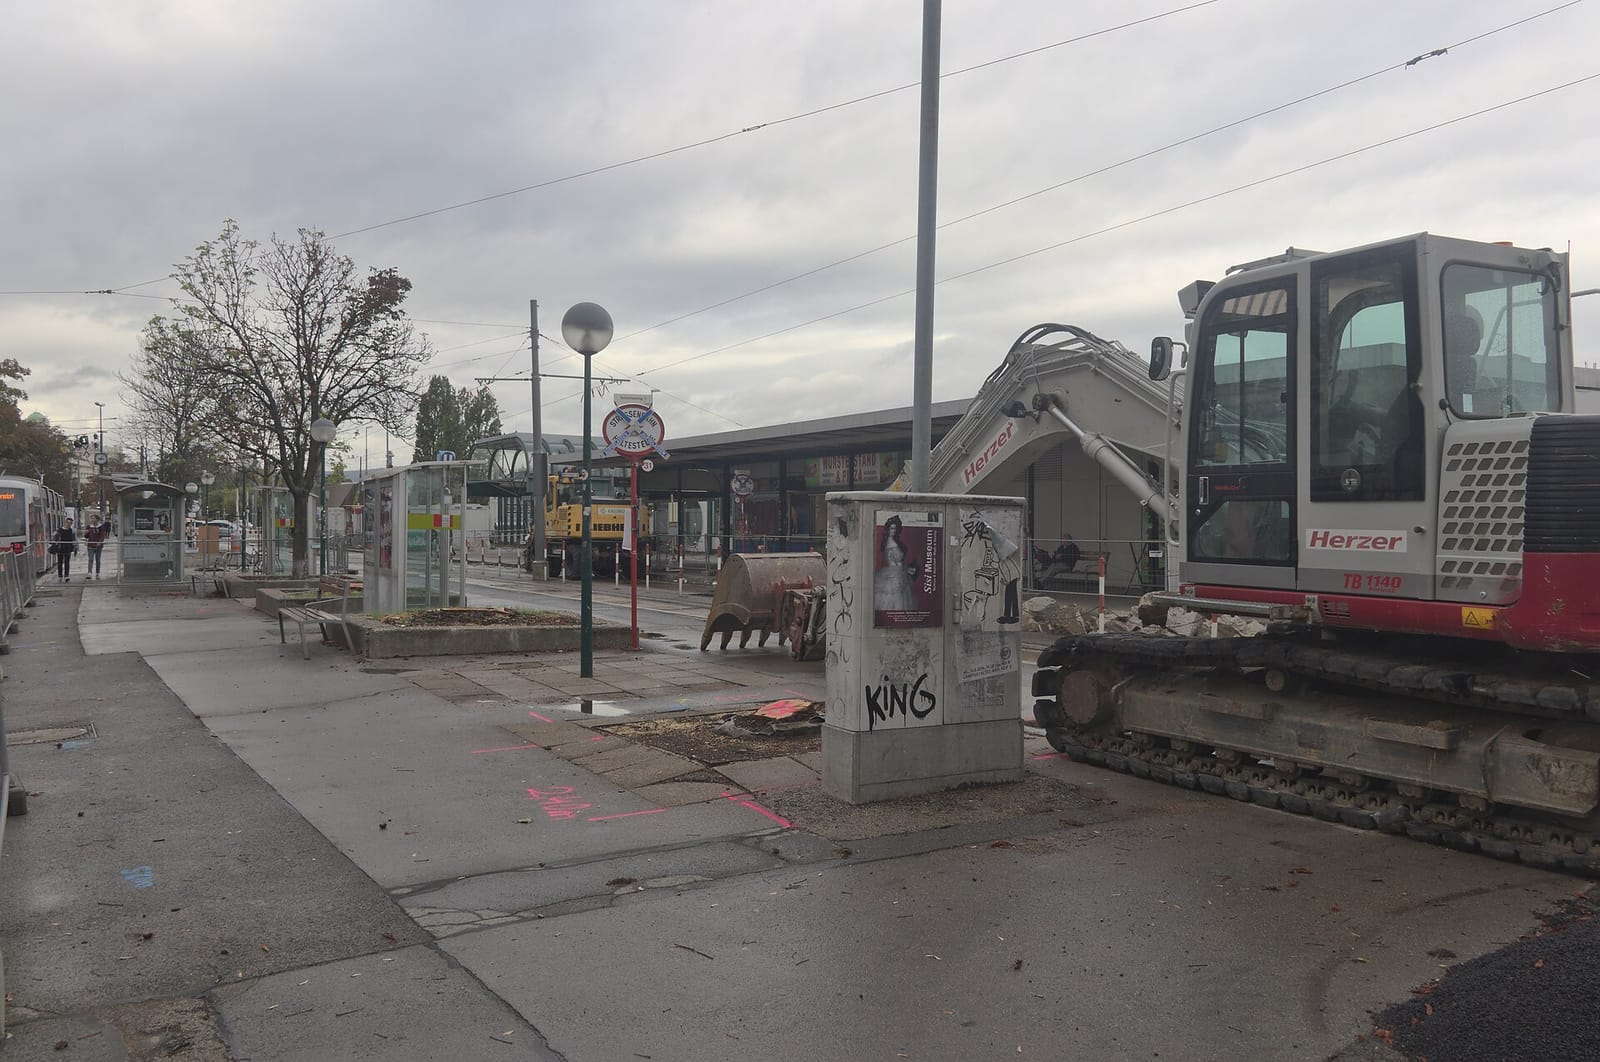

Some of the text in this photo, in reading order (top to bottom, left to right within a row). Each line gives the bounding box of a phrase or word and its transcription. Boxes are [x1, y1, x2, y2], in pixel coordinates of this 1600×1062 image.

[964, 421, 1015, 484] Herzer
[643, 462, 653, 470] 31
[1310, 530, 1403, 550] Herzer
[924, 529, 933, 594] Sisi Museum
[1343, 573, 1402, 590] TB 1140
